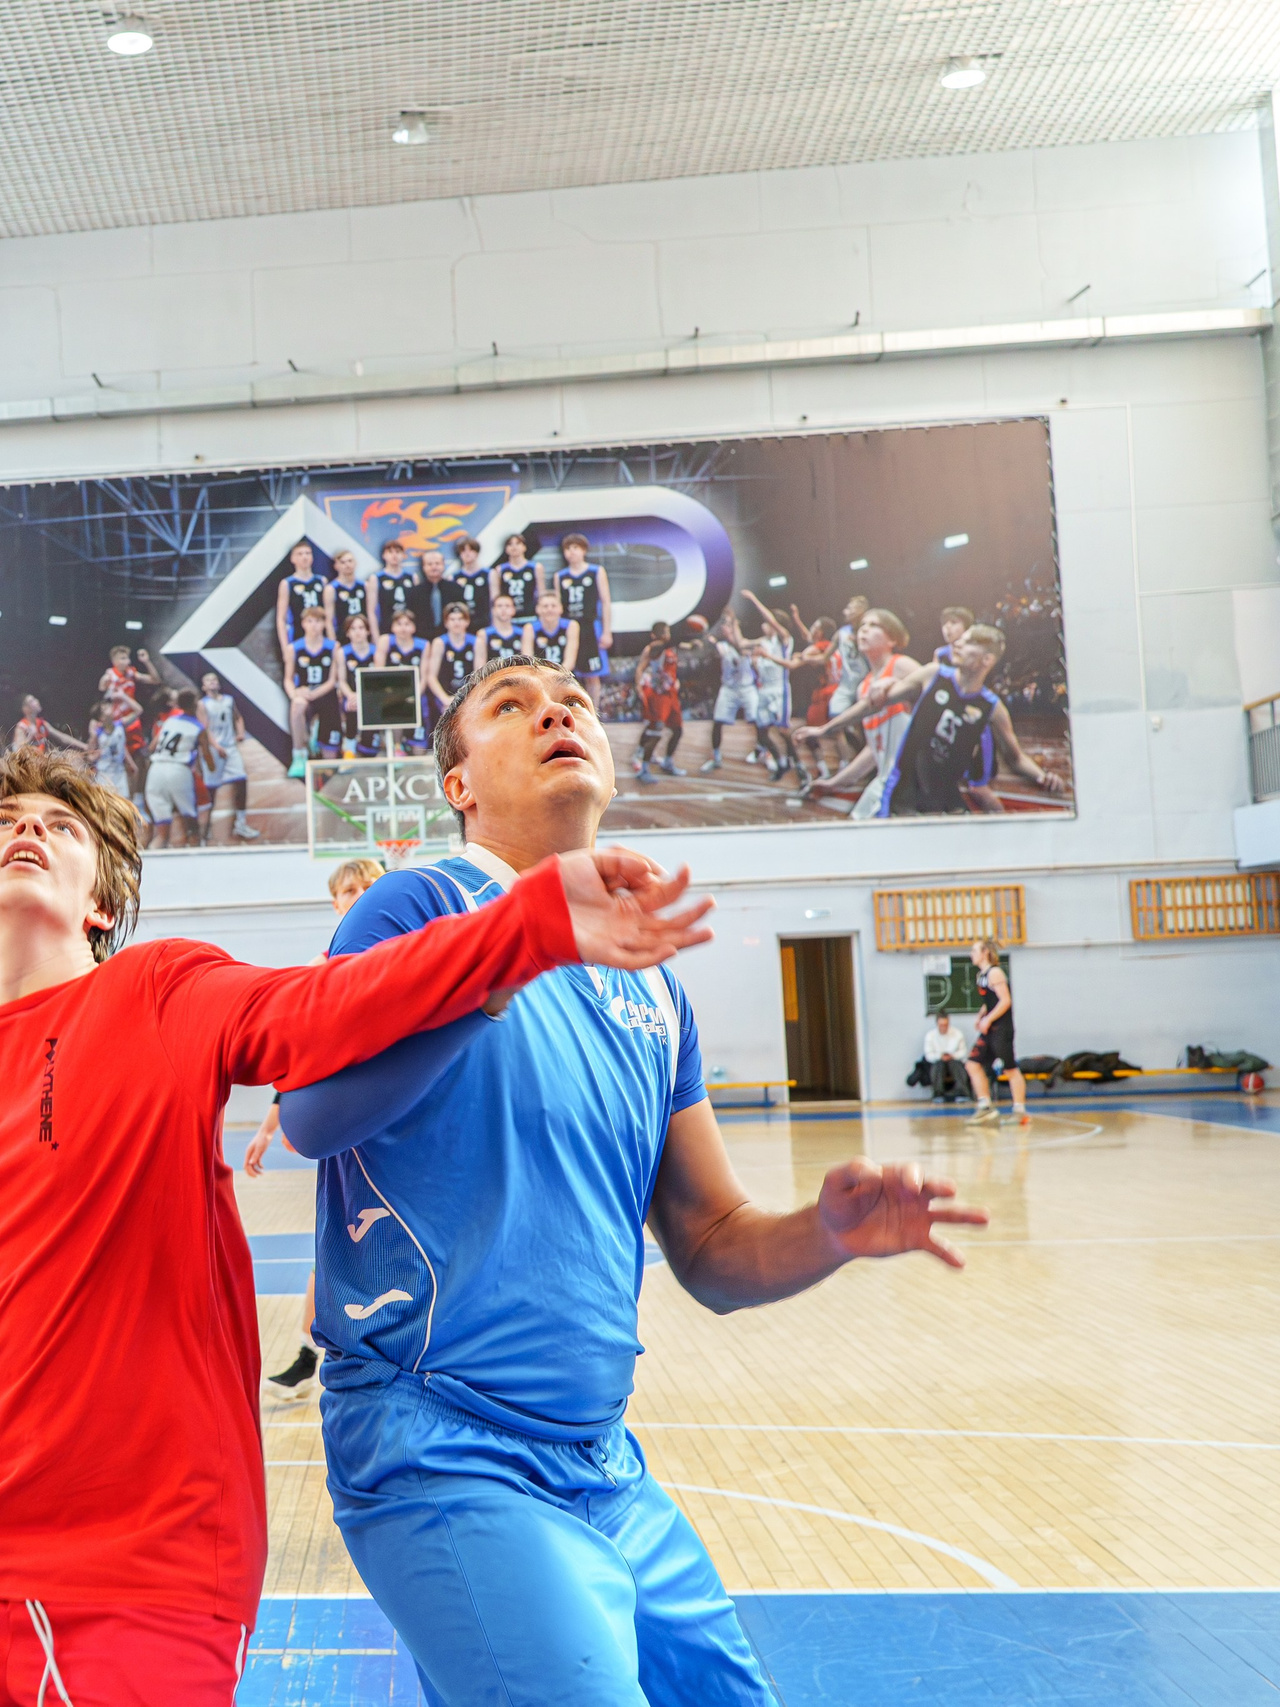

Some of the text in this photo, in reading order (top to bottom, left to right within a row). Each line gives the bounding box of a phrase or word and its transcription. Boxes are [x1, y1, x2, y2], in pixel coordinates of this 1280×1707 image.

[453, 659, 464, 678] 5
[159, 731, 182, 756] 14
[342, 774, 443, 803] АРХСТ
